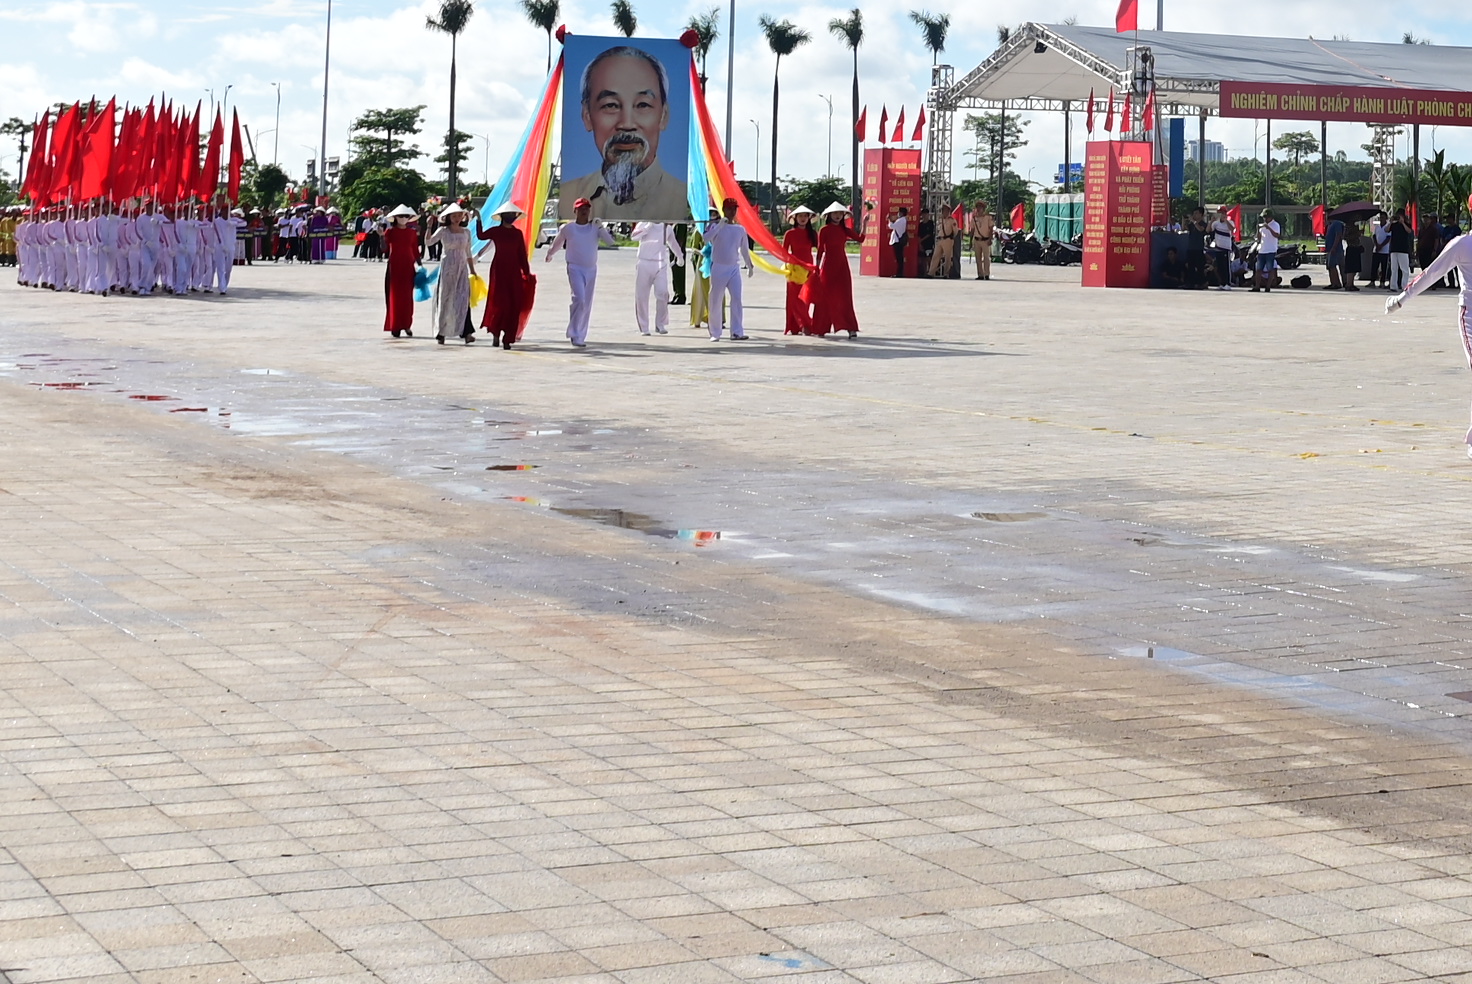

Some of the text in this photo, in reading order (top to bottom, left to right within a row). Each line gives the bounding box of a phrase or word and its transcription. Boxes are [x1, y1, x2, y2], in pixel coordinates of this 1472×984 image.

[1231, 90, 1278, 110] NGHIÊM
[1280, 90, 1317, 112] CHỈNH
[1320, 92, 1350, 113] CHẤP
[1354, 95, 1384, 114] HÀNH
[1387, 97, 1414, 118] LUẬT
[1417, 98, 1454, 117] PHÒNG
